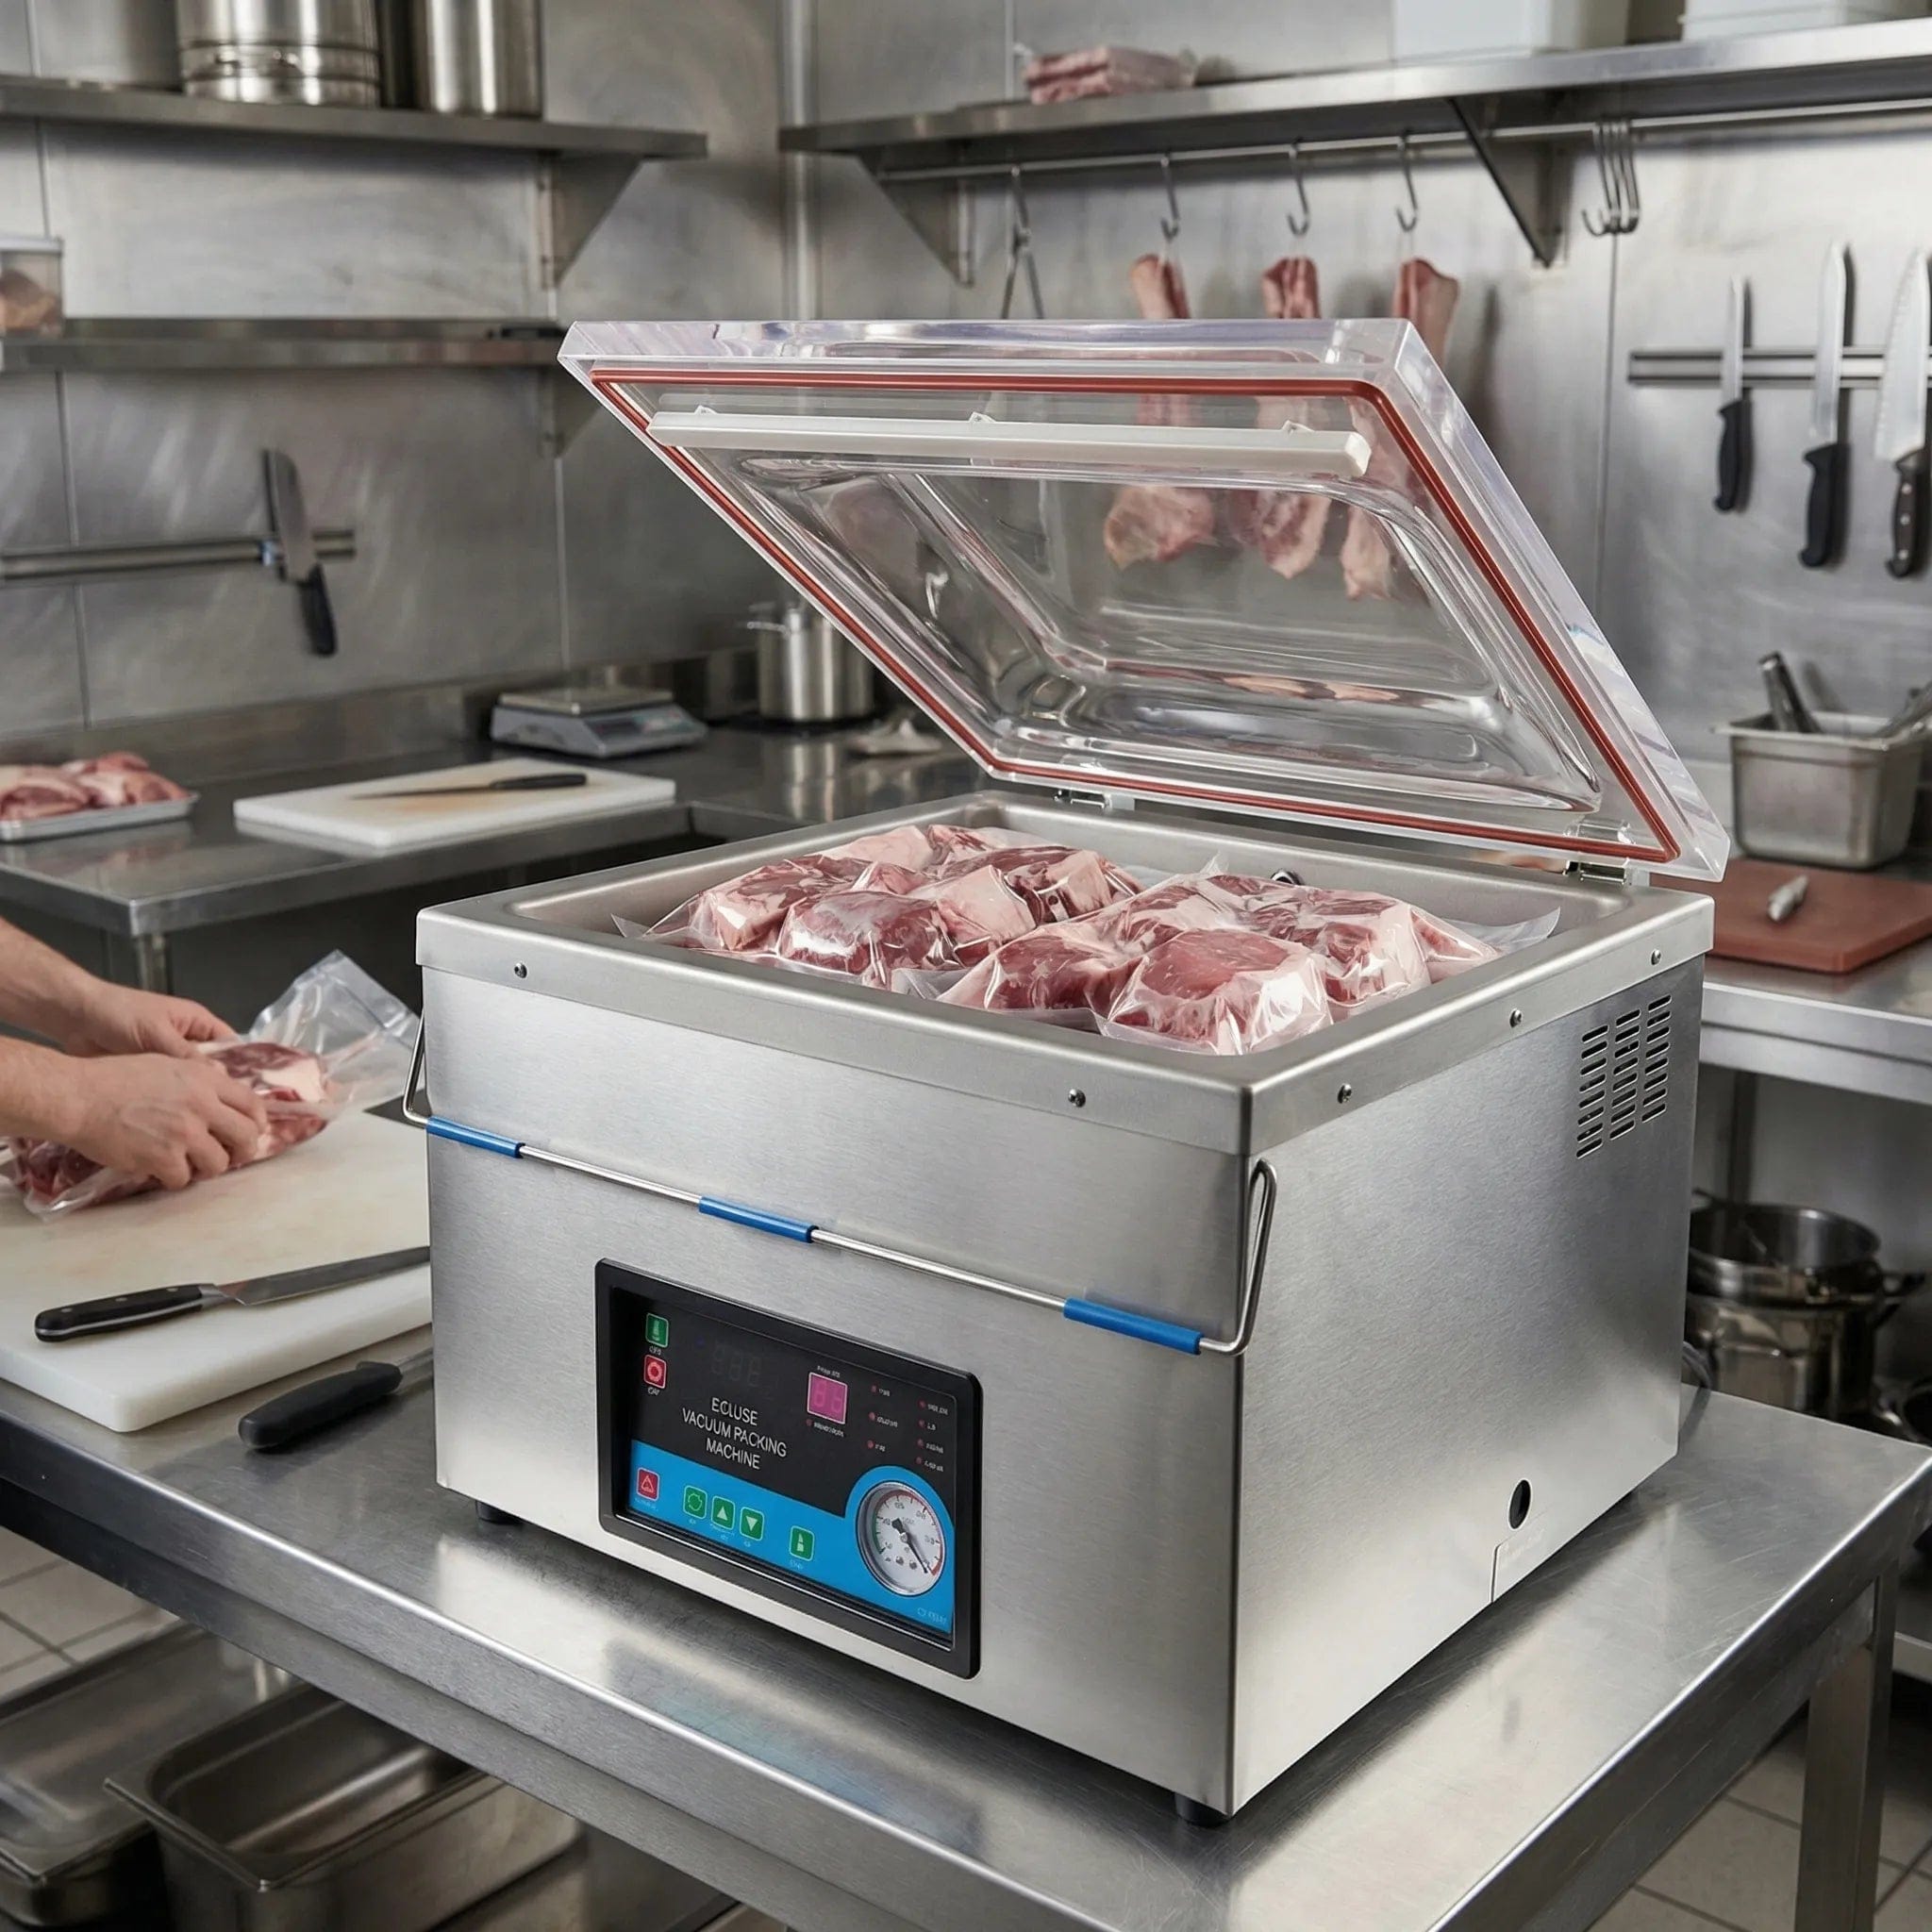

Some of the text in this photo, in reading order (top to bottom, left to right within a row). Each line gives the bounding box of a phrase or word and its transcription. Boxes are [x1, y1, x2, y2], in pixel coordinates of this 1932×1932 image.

[682, 1407, 731, 1439] VACUUM
[734, 1426, 787, 1457] PACKING
[707, 1438, 760, 1470] MACHINE
